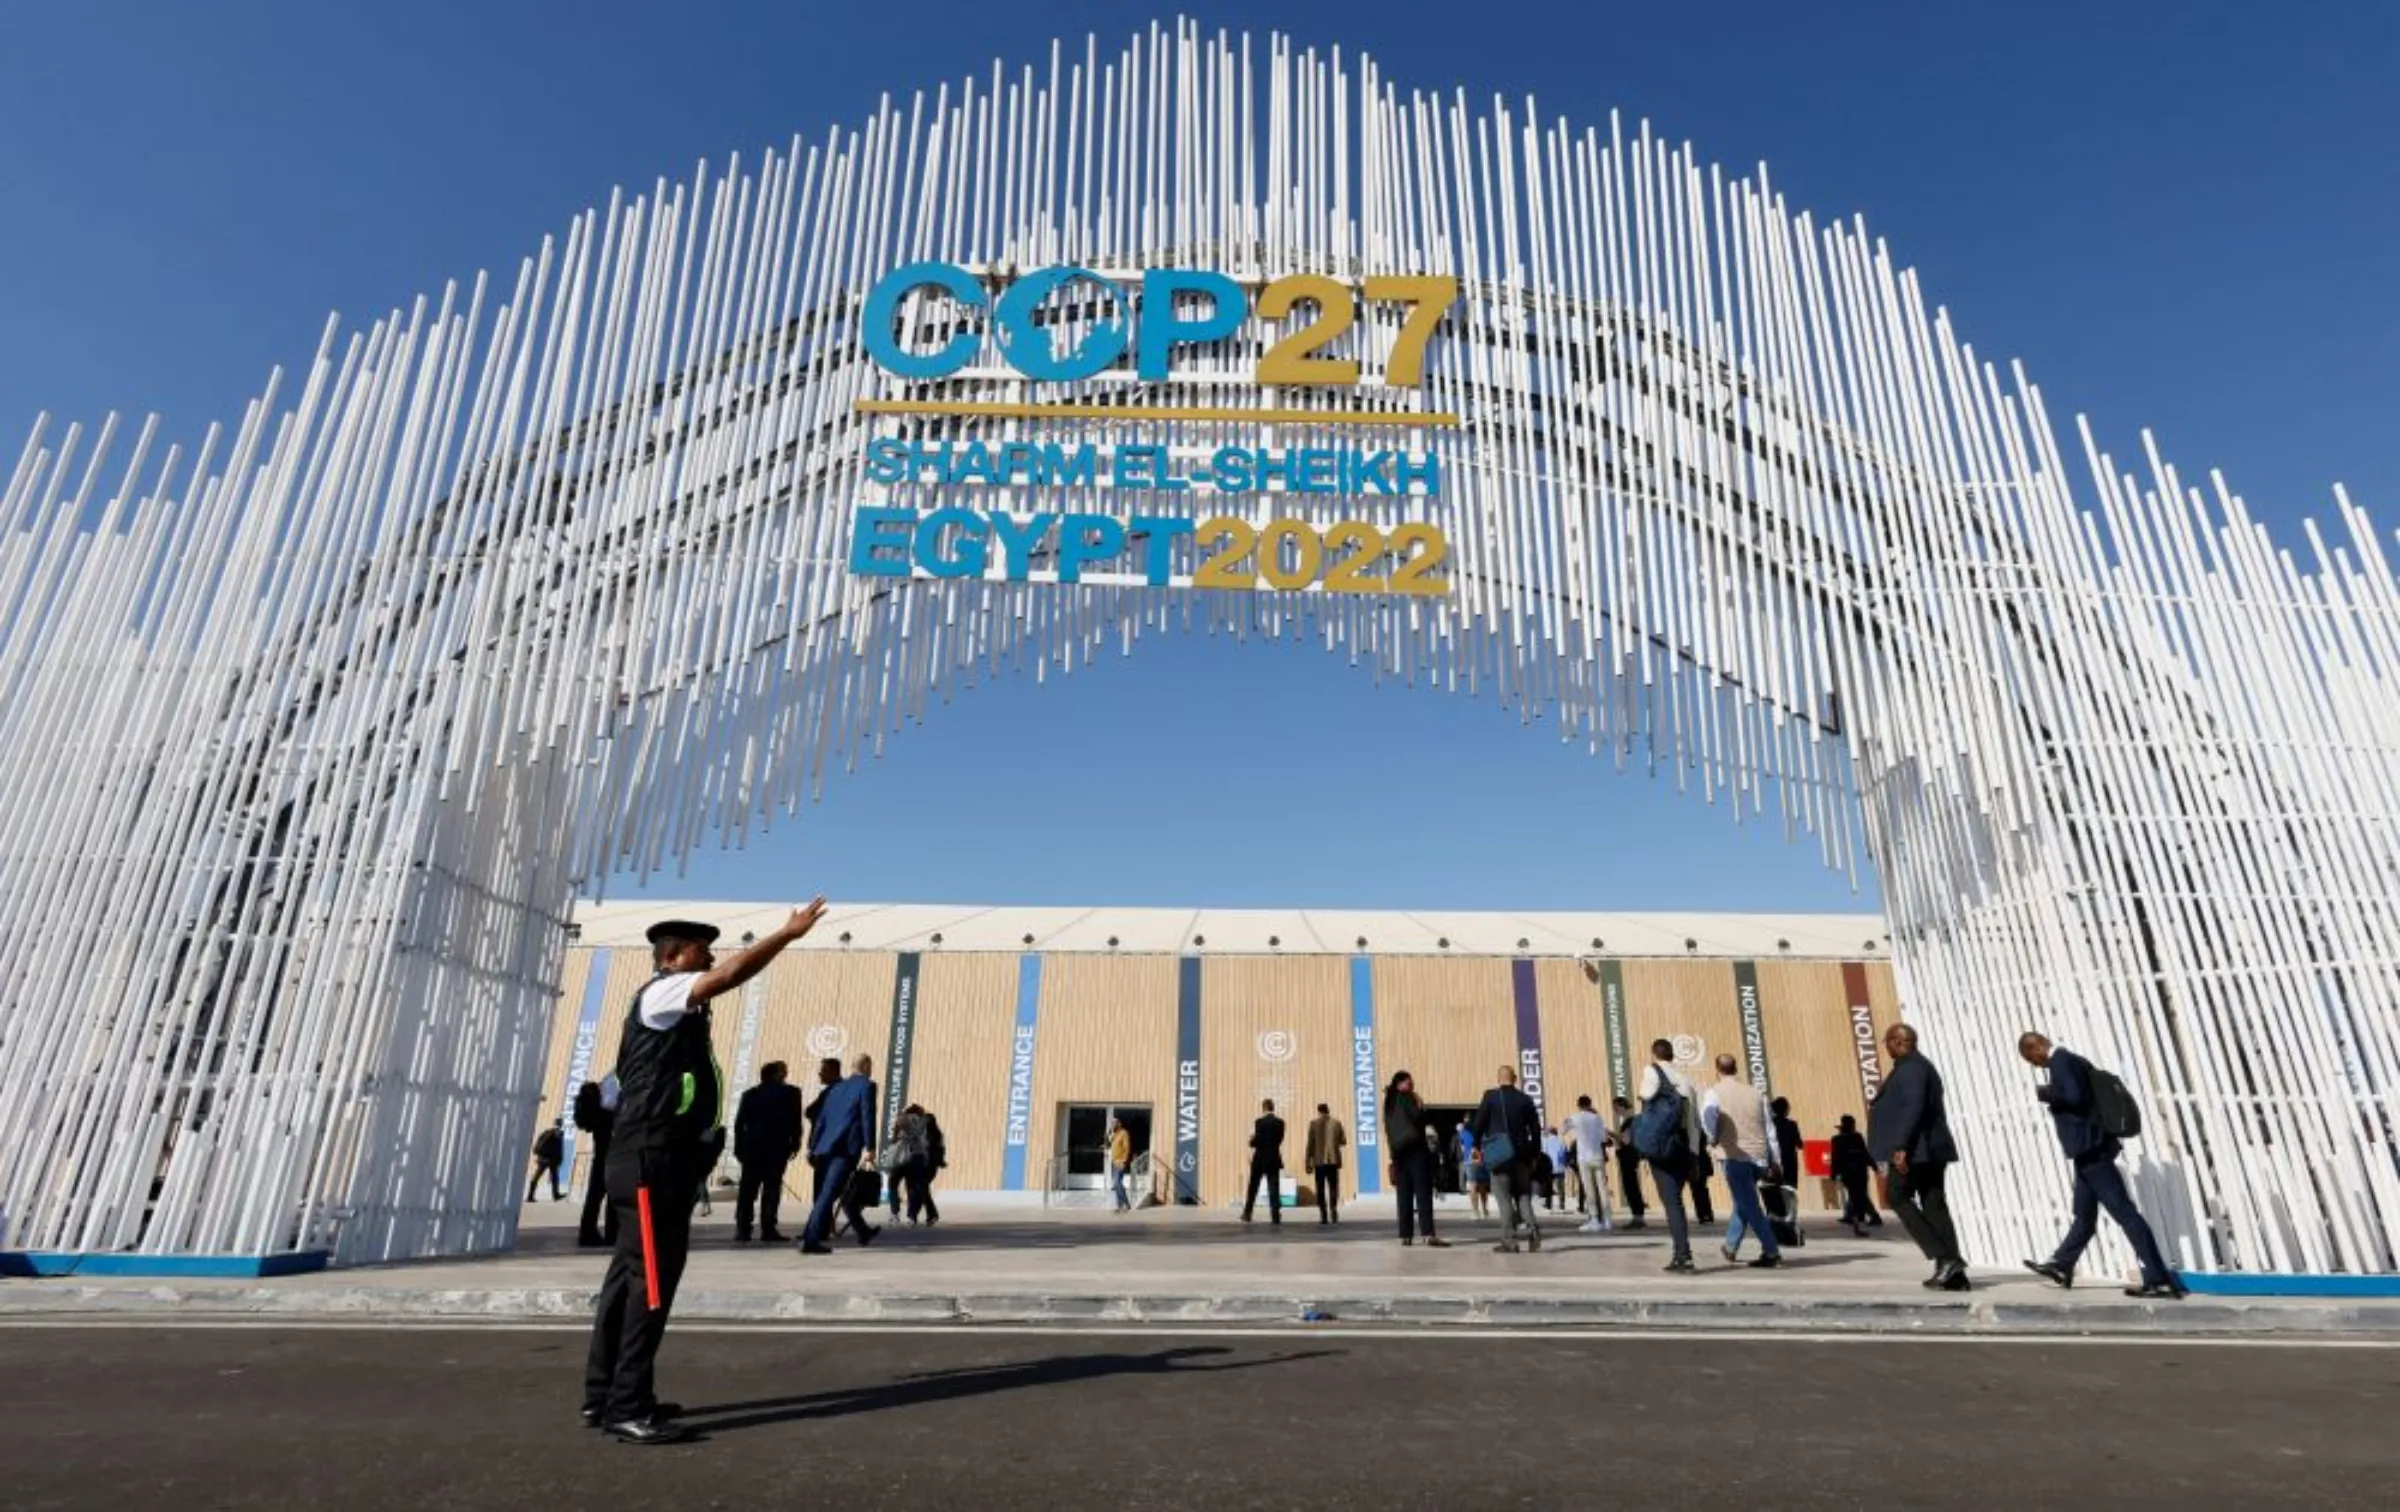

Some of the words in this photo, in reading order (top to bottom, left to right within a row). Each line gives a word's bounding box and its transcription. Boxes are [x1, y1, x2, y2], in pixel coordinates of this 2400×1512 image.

[865, 439, 1094, 486] SHARM
[1114, 443, 1440, 497] EL-SHEIKH
[848, 506, 1195, 586] EGYPT
[1191, 515, 1452, 594] 2022
[561, 1021, 597, 1140] ENTRANCE
[1007, 1024, 1035, 1147] ENTRANCE
[1178, 1058, 1199, 1143] WATER
[1355, 1025, 1377, 1146] ENTRANCE
